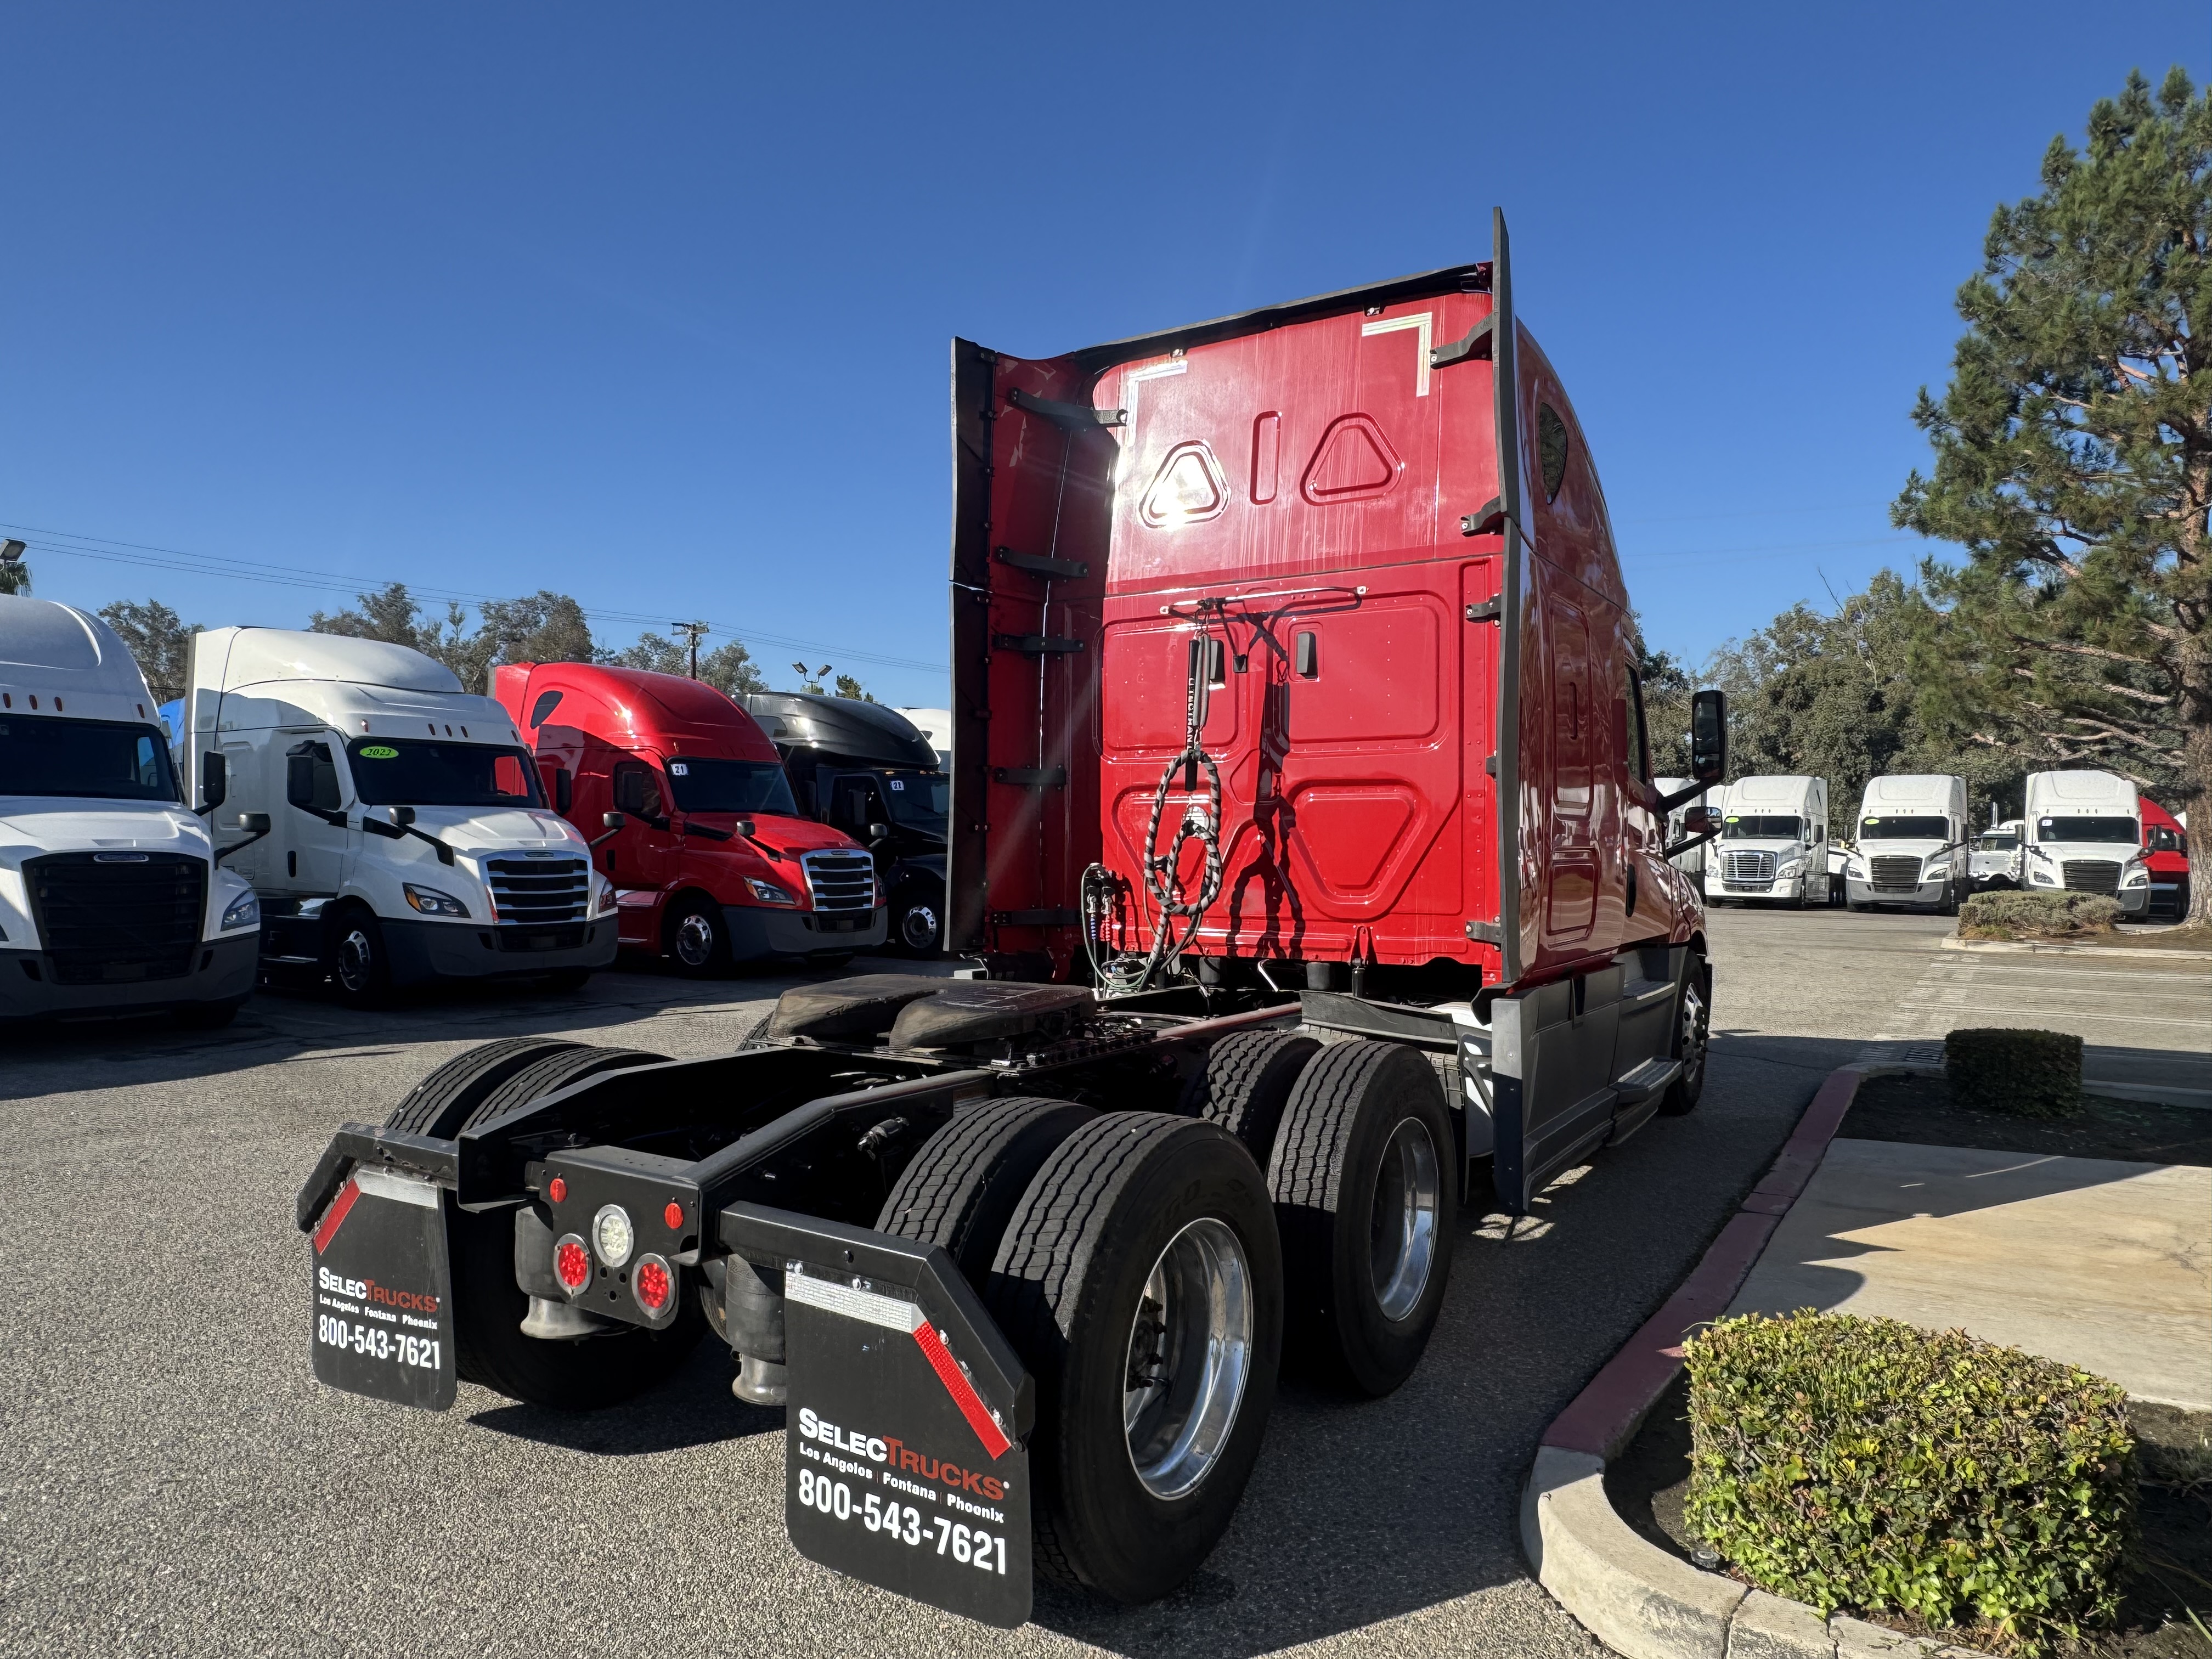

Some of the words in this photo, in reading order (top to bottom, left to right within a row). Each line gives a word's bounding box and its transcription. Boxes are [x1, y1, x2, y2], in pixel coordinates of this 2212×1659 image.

[319, 1314, 439, 1369] 800-543-7621
[320, 1294, 331, 1306] Los
[331, 1298, 359, 1314] Angeles
[364, 1306, 397, 1322] Fontana
[402, 1314, 438, 1330] Phoenix
[799, 1442, 820, 1461] Los
[822, 1452, 873, 1479] Angeles
[883, 1472, 936, 1502] Fontana
[947, 1493, 1005, 1523] Phoenix
[799, 1469, 1006, 1575] 800-543-7621
